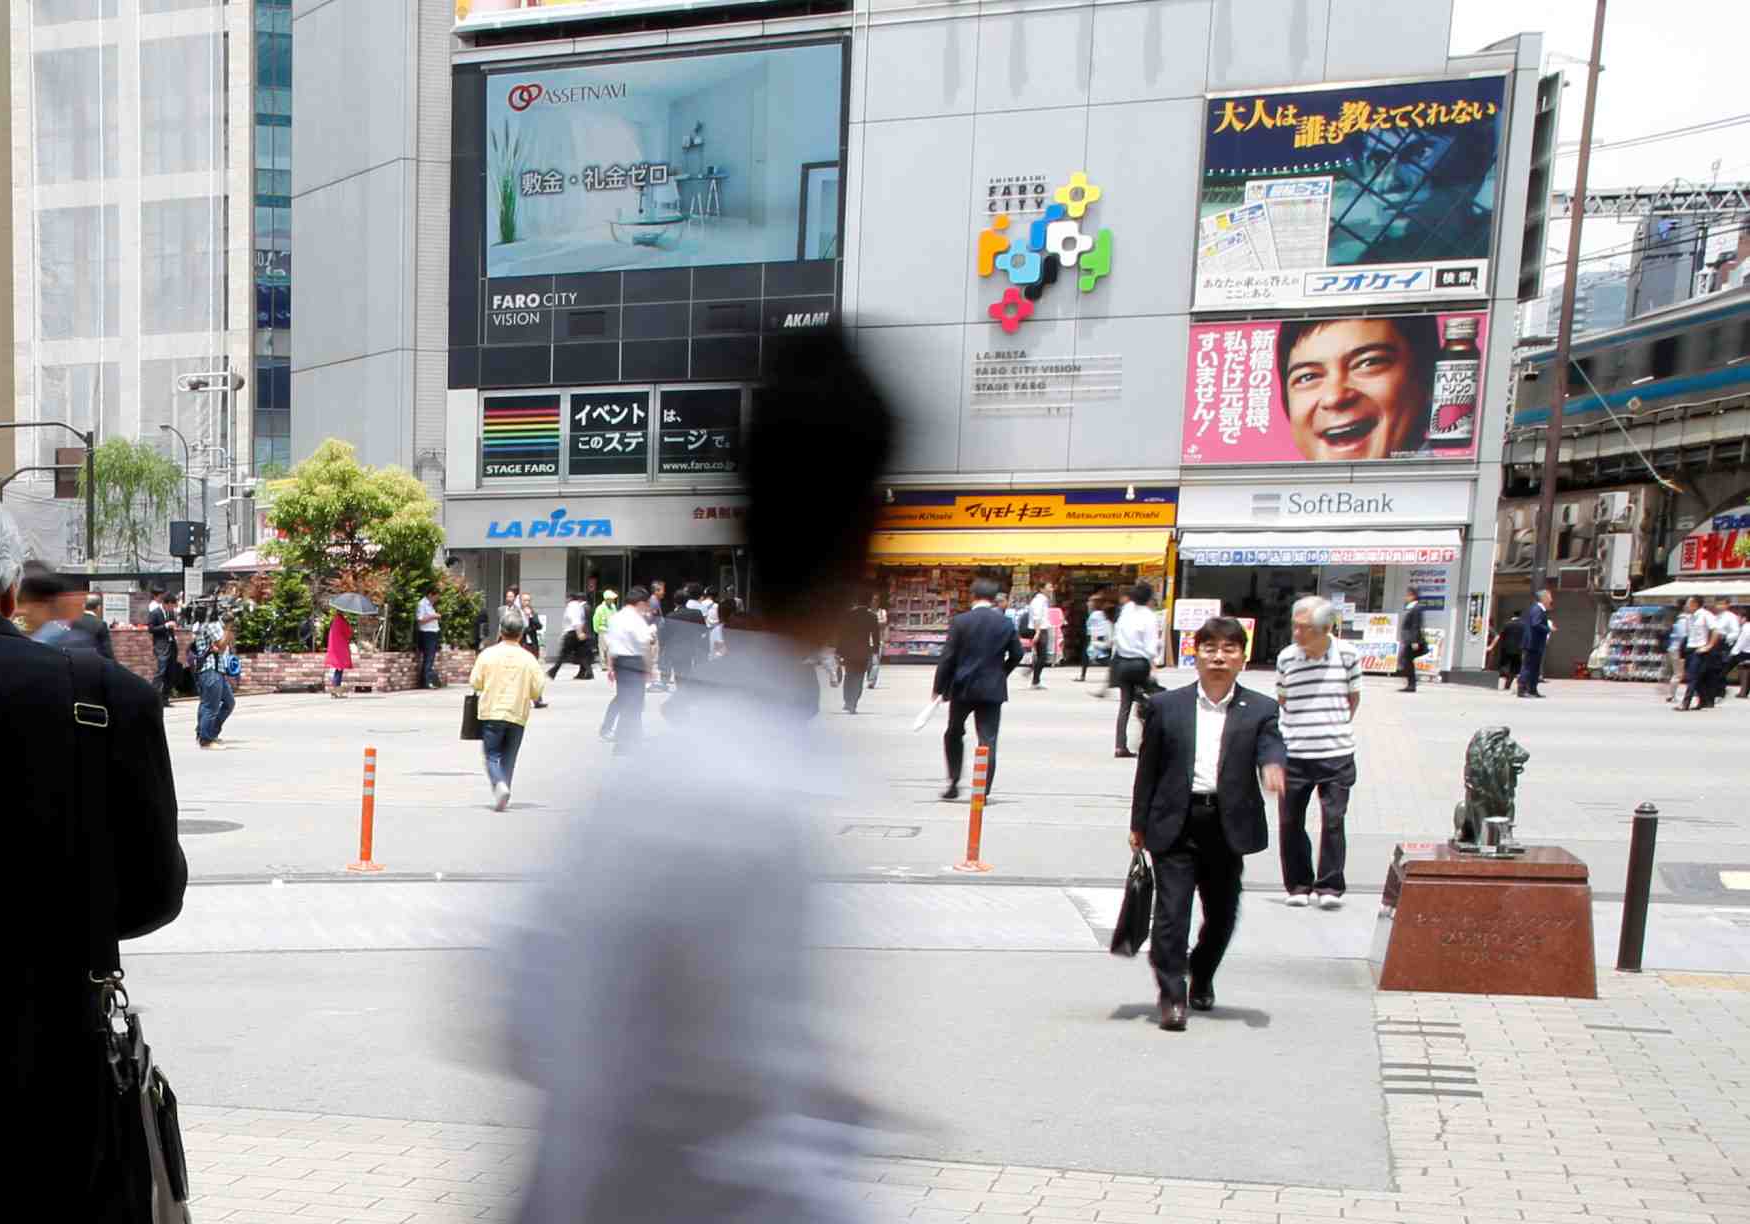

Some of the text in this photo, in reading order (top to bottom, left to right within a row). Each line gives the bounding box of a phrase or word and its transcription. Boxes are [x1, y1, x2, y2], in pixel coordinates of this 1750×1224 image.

[541, 82, 627, 105] ASSETNAVI
[1213, 98, 1497, 149] 大人は誰も教えてくれない
[521, 164, 669, 195] 敷金・礼金ゼロ
[988, 184, 1045, 197] FARO
[988, 199, 1044, 213] CITY
[1313, 271, 1424, 291] アオケイ
[492, 292, 577, 310] FARO CITY
[492, 311, 540, 327] VISION
[1218, 329, 1248, 445] 私だけ元気で
[1245, 329, 1276, 435] 新橋の皆様、
[486, 463, 555, 475] STAGE FARO
[965, 502, 1014, 522] マツモト
[1287, 492, 1394, 515] SoftBank
[486, 520, 523, 539] LA
